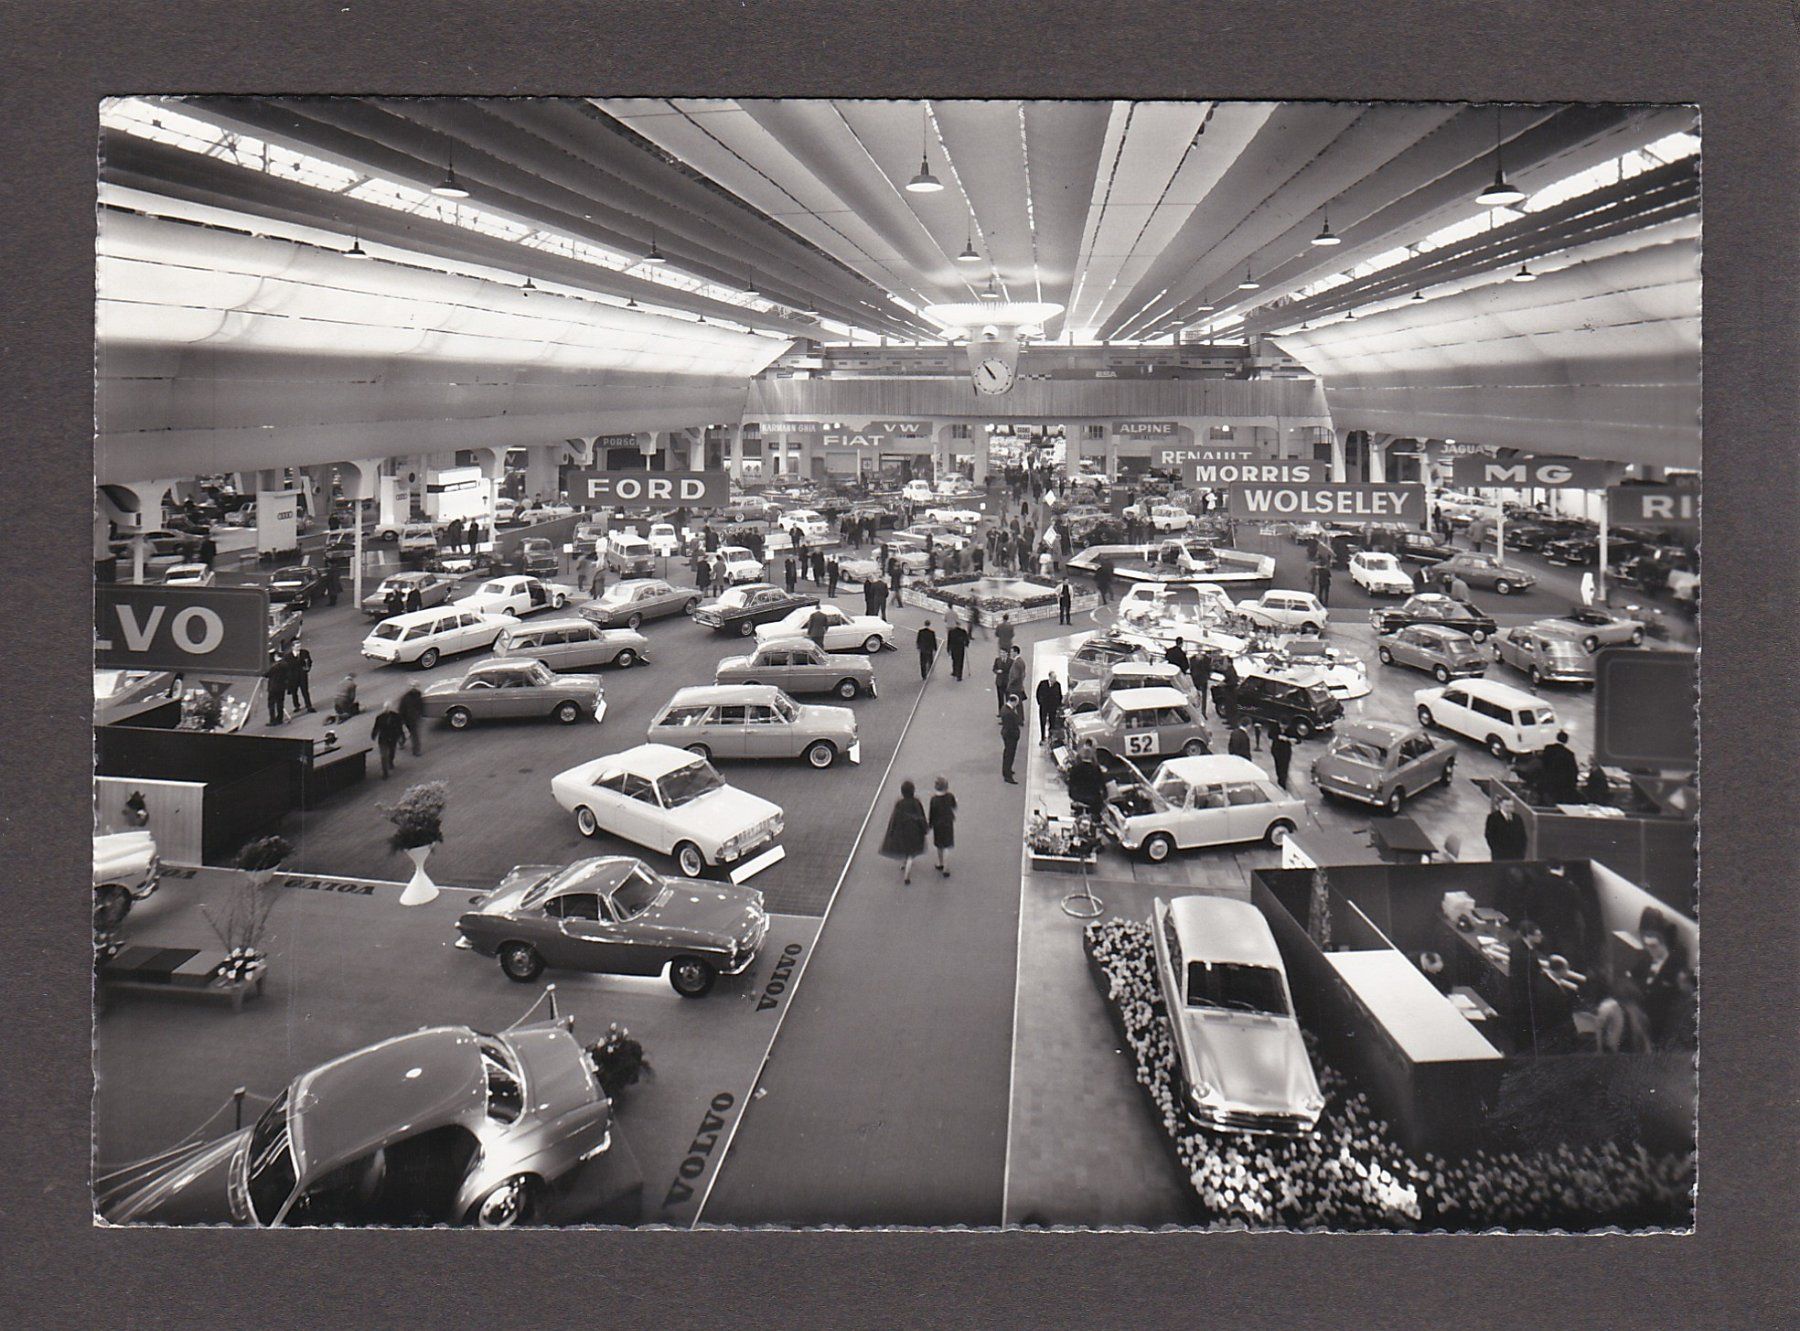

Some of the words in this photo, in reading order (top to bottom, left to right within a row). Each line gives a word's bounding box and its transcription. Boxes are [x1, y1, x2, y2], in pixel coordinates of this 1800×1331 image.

[883, 423, 920, 432] VW
[1119, 423, 1172, 434] ALPINE
[823, 435, 885, 446] FIAT
[1440, 443, 1485, 455] JAGUA
[1195, 465, 1311, 483] MORRIS
[1485, 464, 1573, 484] MG
[587, 478, 706, 500] FORD
[1244, 489, 1409, 515] WOLSELEY
[95, 604, 225, 655] VO
[1128, 735, 1153, 754] 52
[756, 943, 803, 1012] VOLVO
[662, 1092, 735, 1208] VOLVO
